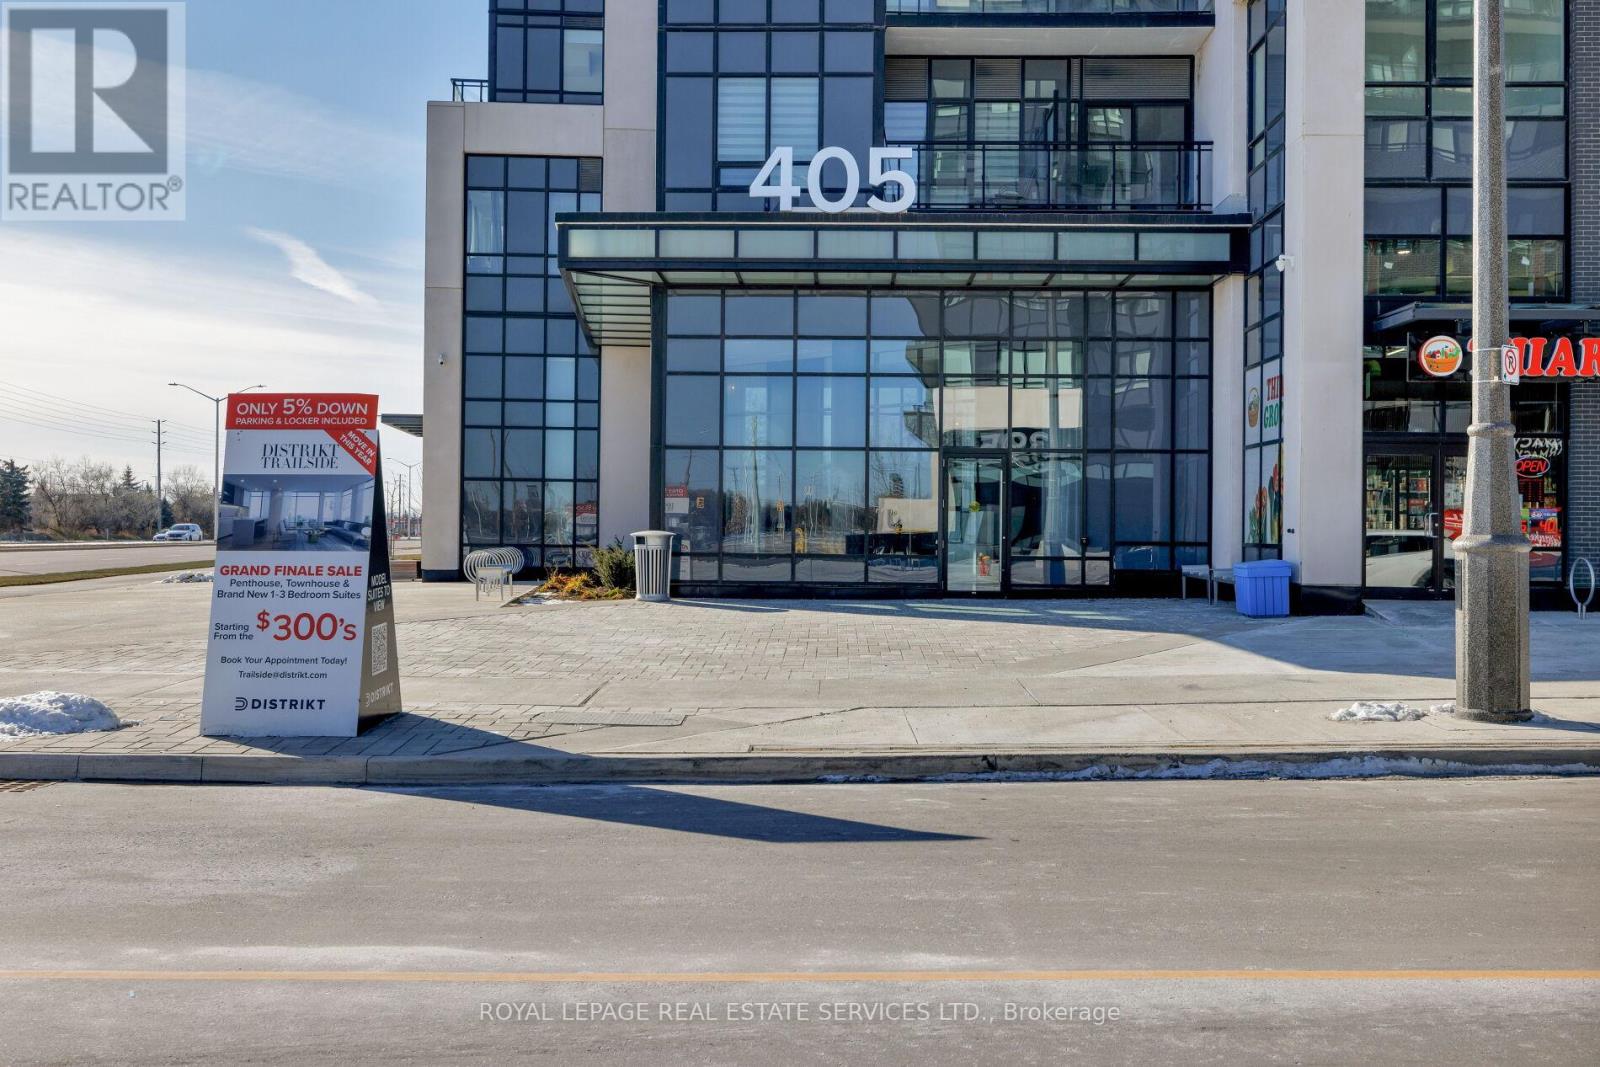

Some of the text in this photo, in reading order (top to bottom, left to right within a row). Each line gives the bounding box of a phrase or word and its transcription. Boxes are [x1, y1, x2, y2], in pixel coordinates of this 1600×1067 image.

[749, 146, 916, 213] 405
[236, 398, 368, 415] ONLY 5% DOWN
[235, 417, 367, 425] PARKING & LOCKER INCLUDED
[339, 434, 372, 465] THIS YEAR
[347, 430, 376, 457] MOVE IN
[262, 443, 340, 457] DISTRIKT
[261, 456, 339, 469] TRAILSIDE
[1515, 460, 1546, 472] OPEN
[220, 565, 363, 577] GRAND FINALE SALE
[229, 578, 350, 588] Penthouse, Townhouse &
[217, 589, 361, 599] Brand New 1-3 Bedroom Suites
[214, 622, 250, 633] Starting
[213, 632, 254, 641] From the
[220, 656, 348, 667] Book Your Appointment Today!
[238, 670, 328, 680] Trailside@distrikt.com
[251, 698, 326, 710] DISTRIKT
